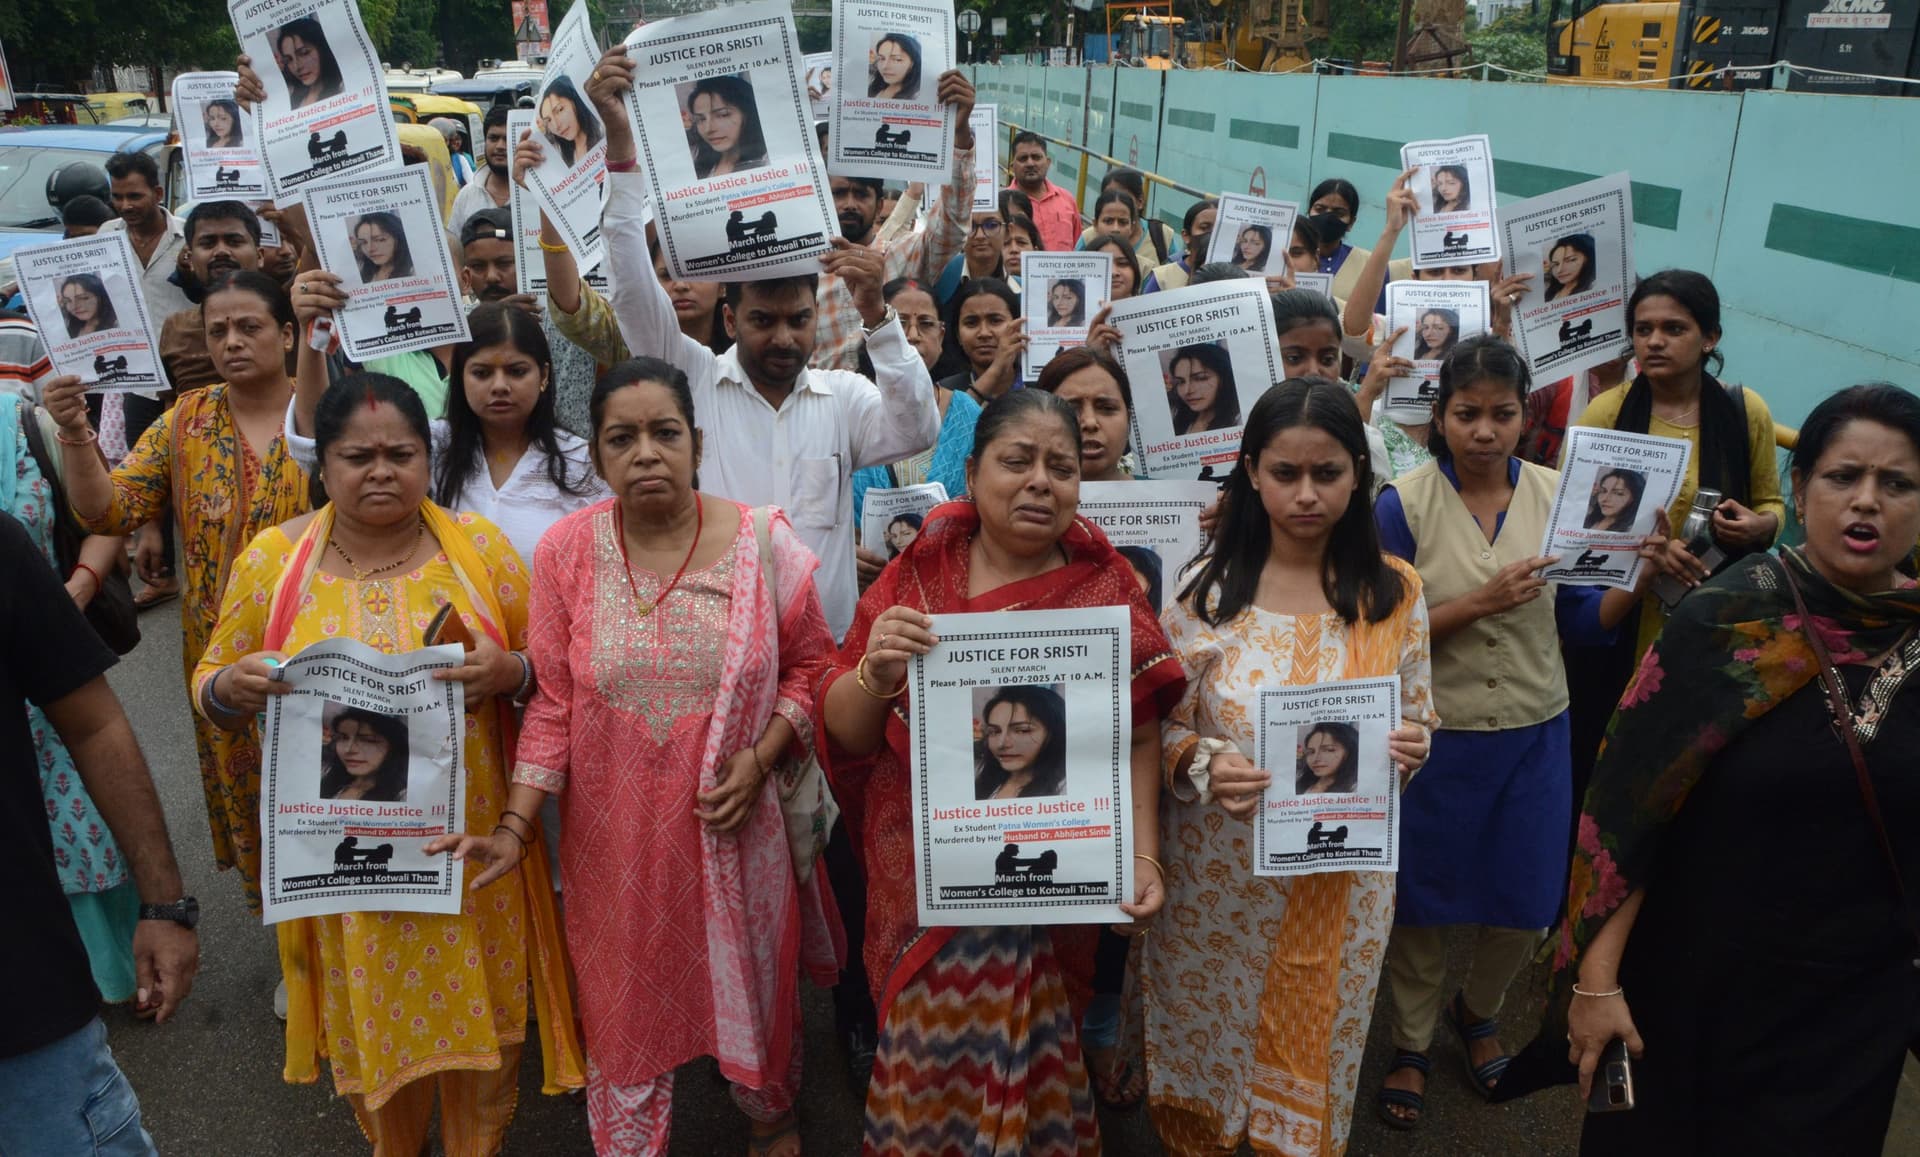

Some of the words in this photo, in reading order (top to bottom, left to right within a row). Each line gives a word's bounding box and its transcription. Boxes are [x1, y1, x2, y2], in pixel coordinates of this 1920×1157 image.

[245, 0, 274, 19] JUSTICE
[857, 9, 888, 18] JUSTICE
[891, 12, 907, 20] FOR
[909, 15, 931, 24] SRISTI
[649, 47, 696, 66] JUSTICE
[700, 42, 724, 56] FOR
[727, 35, 763, 51] SRISTI
[639, 79, 661, 89] Please
[662, 76, 677, 87] Join
[694, 65, 736, 78] 10-07-2025
[753, 60, 761, 68] 10
[763, 57, 781, 66] A.M.
[265, 114, 294, 129] Justice
[297, 105, 326, 119] Justice
[329, 94, 358, 108] Justice
[843, 100, 870, 108] Justice
[873, 102, 899, 110] Justice
[902, 103, 929, 111] Justice
[326, 192, 359, 203] JUSTICE
[362, 188, 378, 197] FOR
[381, 184, 408, 194] SRISTI
[551, 175, 576, 195] Justice
[666, 185, 705, 201] Justice
[709, 178, 747, 192] Justice
[750, 169, 788, 183] Justice
[1525, 219, 1558, 233] JUSTICE
[1560, 212, 1577, 225] FOR
[1579, 203, 1605, 217] SRISTI
[728, 238, 755, 249] March
[757, 233, 777, 243] from
[33, 256, 64, 267] JUSTICE
[66, 253, 82, 261] FOR
[84, 248, 107, 258] SRISTI
[685, 257, 724, 270] Women's
[726, 251, 755, 264] College
[757, 249, 766, 257] to
[768, 241, 798, 254] Kotwali
[800, 237, 824, 247] Thana
[1136, 319, 1177, 335] JUSTICE
[1181, 313, 1203, 327] FOR
[1206, 306, 1240, 321] SRISTI
[1128, 346, 1145, 354] Please
[1147, 344, 1160, 352] Join
[1176, 334, 1214, 346] 10-07-2025
[1240, 326, 1257, 334] A.M.
[1146, 440, 1181, 454] Justice
[1184, 433, 1219, 448] Justice
[1590, 443, 1622, 454] JUSTICE
[1624, 447, 1640, 455] FOR
[1643, 450, 1667, 460] SRISTI
[1120, 515, 1142, 525] FOR
[1146, 515, 1180, 524] SRISTI
[1556, 528, 1584, 538] Justice
[1585, 531, 1610, 539] Justice
[948, 649, 1005, 663] JUSTICE
[1011, 647, 1039, 659] FOR
[1044, 645, 1087, 658] SRISTI
[991, 666, 1016, 674] SILENT
[305, 666, 357, 682] JUSTICE
[361, 676, 384, 693] FOR
[388, 679, 426, 696] SRISTI
[931, 679, 956, 688] Please
[960, 678, 976, 686] Join
[999, 675, 1049, 684] 10-07-2025
[1084, 672, 1106, 680] A.M.
[314, 689, 330, 698] Join
[348, 697, 394, 713] 10-07-2025
[1282, 700, 1319, 710] JUSTICE
[1322, 697, 1342, 705] FOR
[1345, 695, 1375, 704] SRISTI
[279, 803, 324, 815] Justice
[328, 804, 374, 816] Justice
[378, 806, 423, 817] Justice
[933, 807, 980, 821] Justice
[985, 804, 1033, 817] Justice
[1037, 800, 1085, 815] Justice
[1094, 798, 1110, 810] !!!
[1267, 800, 1298, 808] Justice
[1302, 798, 1333, 806] Justice
[1336, 796, 1368, 804] Justice
[965, 823, 996, 832] Student
[999, 822, 1020, 830] Patna
[1062, 818, 1090, 826] College
[934, 836, 974, 845] Murdered
[976, 836, 985, 844] by
[988, 834, 1002, 842] Her
[1004, 832, 1038, 841] Husband
[1040, 831, 1052, 840] Dr.
[1055, 829, 1087, 839] Abhijeet
[1089, 827, 1110, 836] Sinha
[1302, 852, 1324, 861] College
[1361, 849, 1382, 857] Thana
[335, 862, 364, 871] March
[366, 862, 388, 870] from
[282, 878, 325, 891] Women's
[328, 876, 360, 886] College
[363, 875, 372, 883] to
[375, 874, 409, 883] Kotwali
[412, 873, 438, 882] Thana
[996, 874, 1026, 883] March
[1029, 873, 1053, 881] from
[941, 887, 986, 898] Women's
[989, 886, 1024, 897] College
[1026, 886, 1037, 896] to
[1039, 884, 1076, 895] Kotwali
[1079, 884, 1108, 894] Thana
